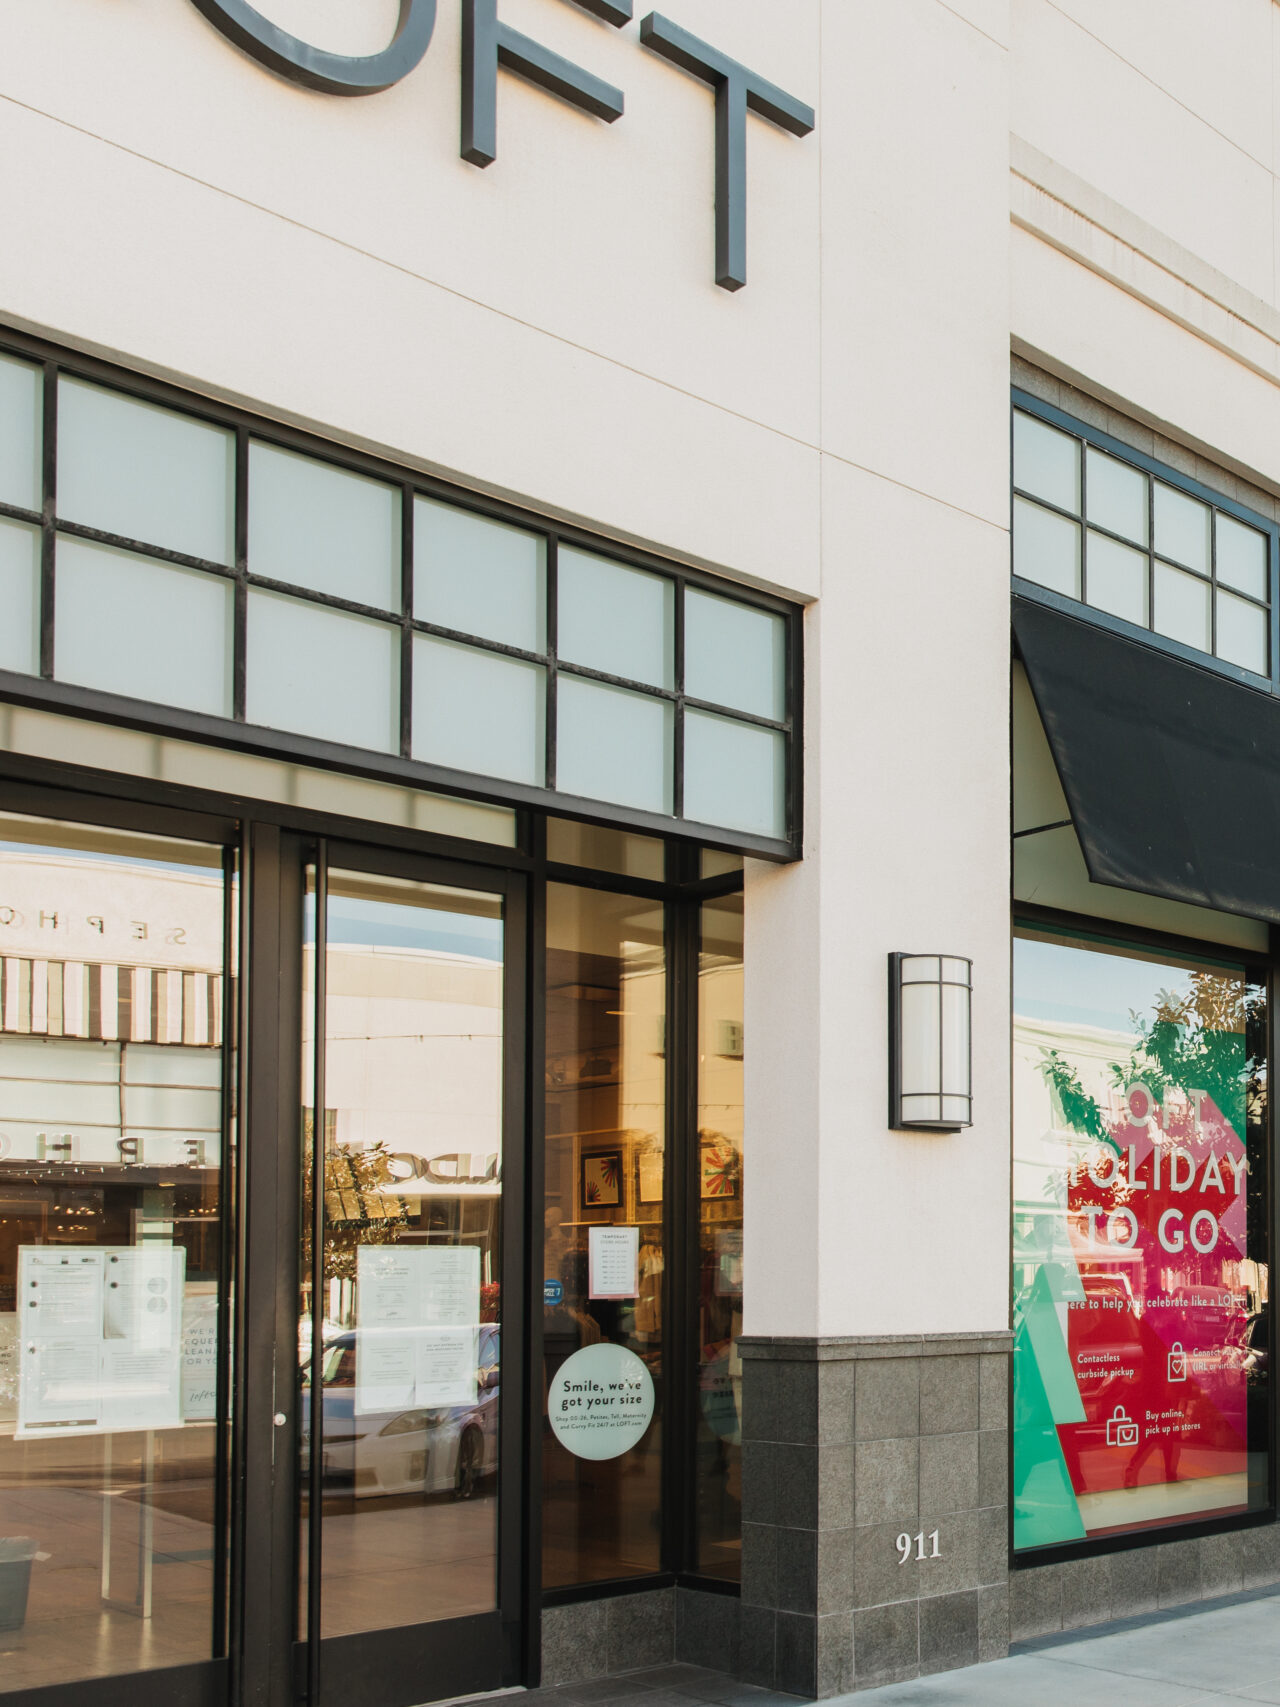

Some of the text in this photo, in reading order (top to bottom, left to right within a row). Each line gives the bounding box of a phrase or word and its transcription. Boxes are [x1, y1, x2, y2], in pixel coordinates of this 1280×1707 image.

[1125, 1081, 1208, 1131] OFT
[1080, 1206, 1219, 1254] TO GO
[1068, 1301, 1086, 1310] ere
[1089, 1300, 1099, 1309] to
[1103, 1297, 1123, 1313] help
[1147, 1296, 1188, 1308] celebrate
[1191, 1295, 1207, 1306] like
[1077, 1354, 1120, 1364] Contactless
[1192, 1348, 1220, 1357] Connect
[1077, 1368, 1134, 1380] curbside pickup
[563, 1379, 641, 1393] Smile, we've
[561, 1393, 642, 1411] got your size
[1145, 1408, 1185, 1422] Buy online,
[1145, 1422, 1201, 1438] pick up in stores
[895, 1529, 942, 1564] 911
